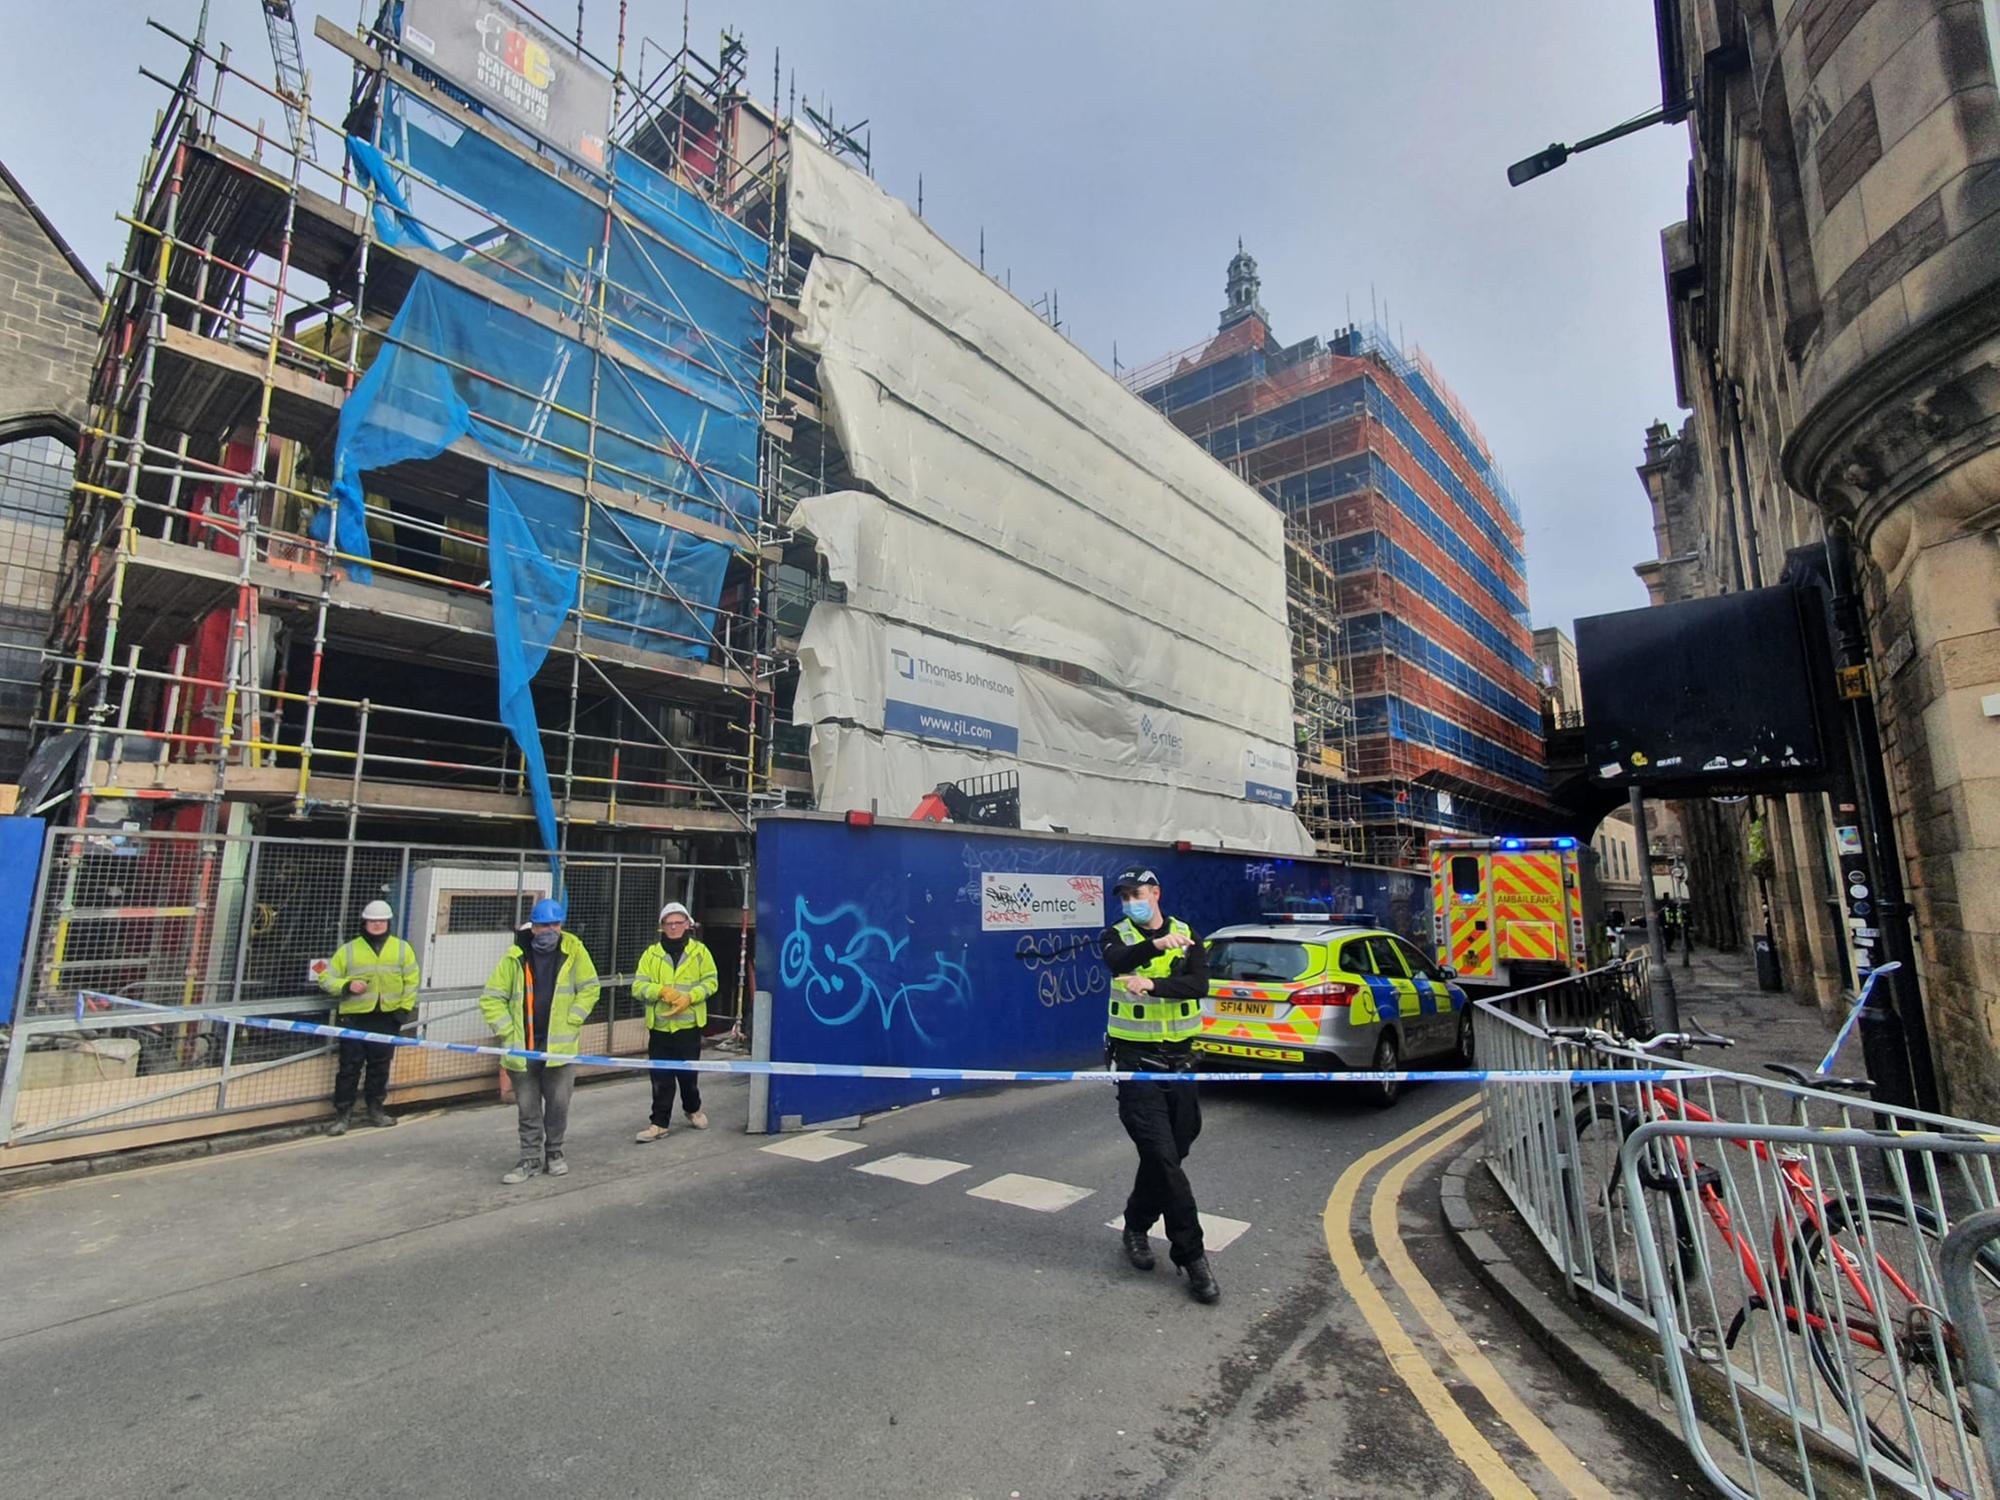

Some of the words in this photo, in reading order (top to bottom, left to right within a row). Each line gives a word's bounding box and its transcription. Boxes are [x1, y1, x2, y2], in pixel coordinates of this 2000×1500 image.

[478, 51, 549, 108] SCAFFOLDING
[918, 658, 963, 682] Thomas
[965, 672, 1014, 697] Johnstone
[919, 714, 992, 740] www.tjl.com
[1031, 898, 1076, 912] emtec
[1220, 1002, 1242, 1012] SF14
[1245, 1003, 1267, 1014] NNV
